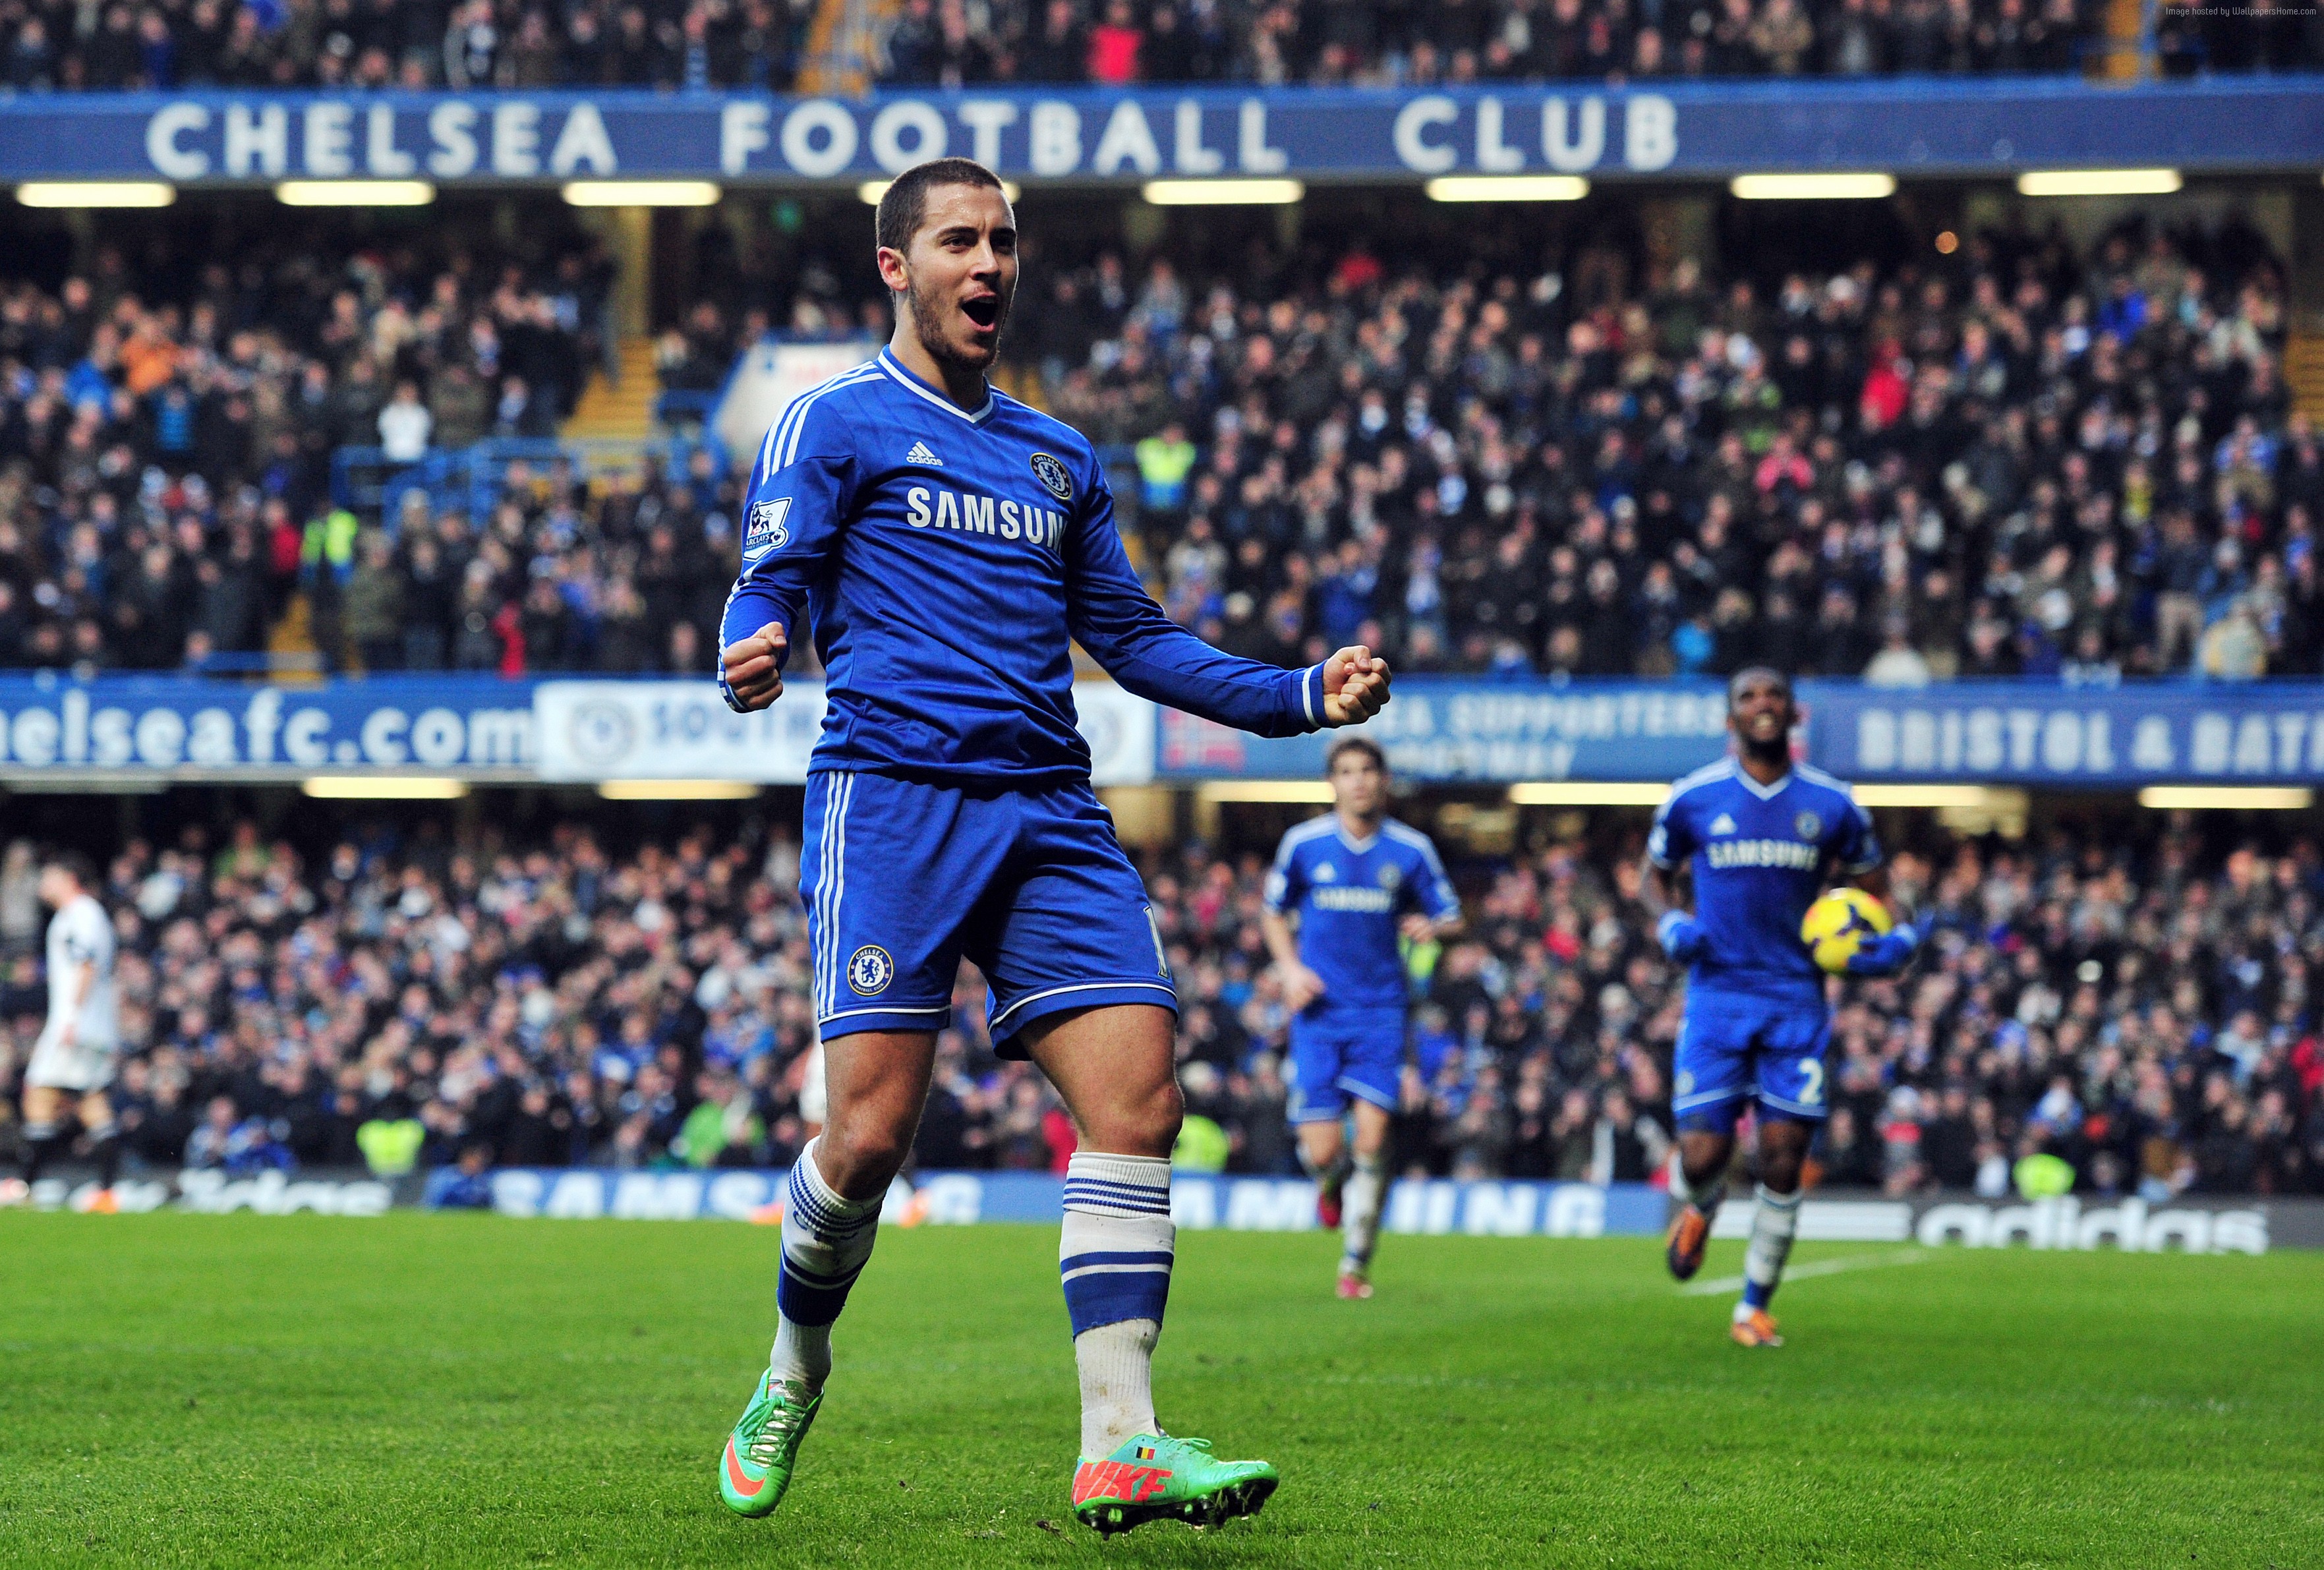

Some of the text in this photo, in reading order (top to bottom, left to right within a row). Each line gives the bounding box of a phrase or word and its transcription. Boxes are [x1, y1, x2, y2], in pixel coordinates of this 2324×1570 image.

[146, 95, 1678, 179] CHELSEA FOOTBALL CLUB
[906, 454, 943, 467] adidas
[746, 533, 770, 546] ARCLAYS
[907, 487, 1067, 554] SAMSUN
[0, 687, 534, 767] elseafc.com
[1859, 709, 2114, 772] BRISTOL
[2191, 712, 2324, 775] BAT
[856, 949, 884, 960] CHELSEA
[492, 1171, 981, 1225] SAMSG
[1170, 1177, 1607, 1237] AMUNG
[1915, 1194, 2271, 1255] adidas
